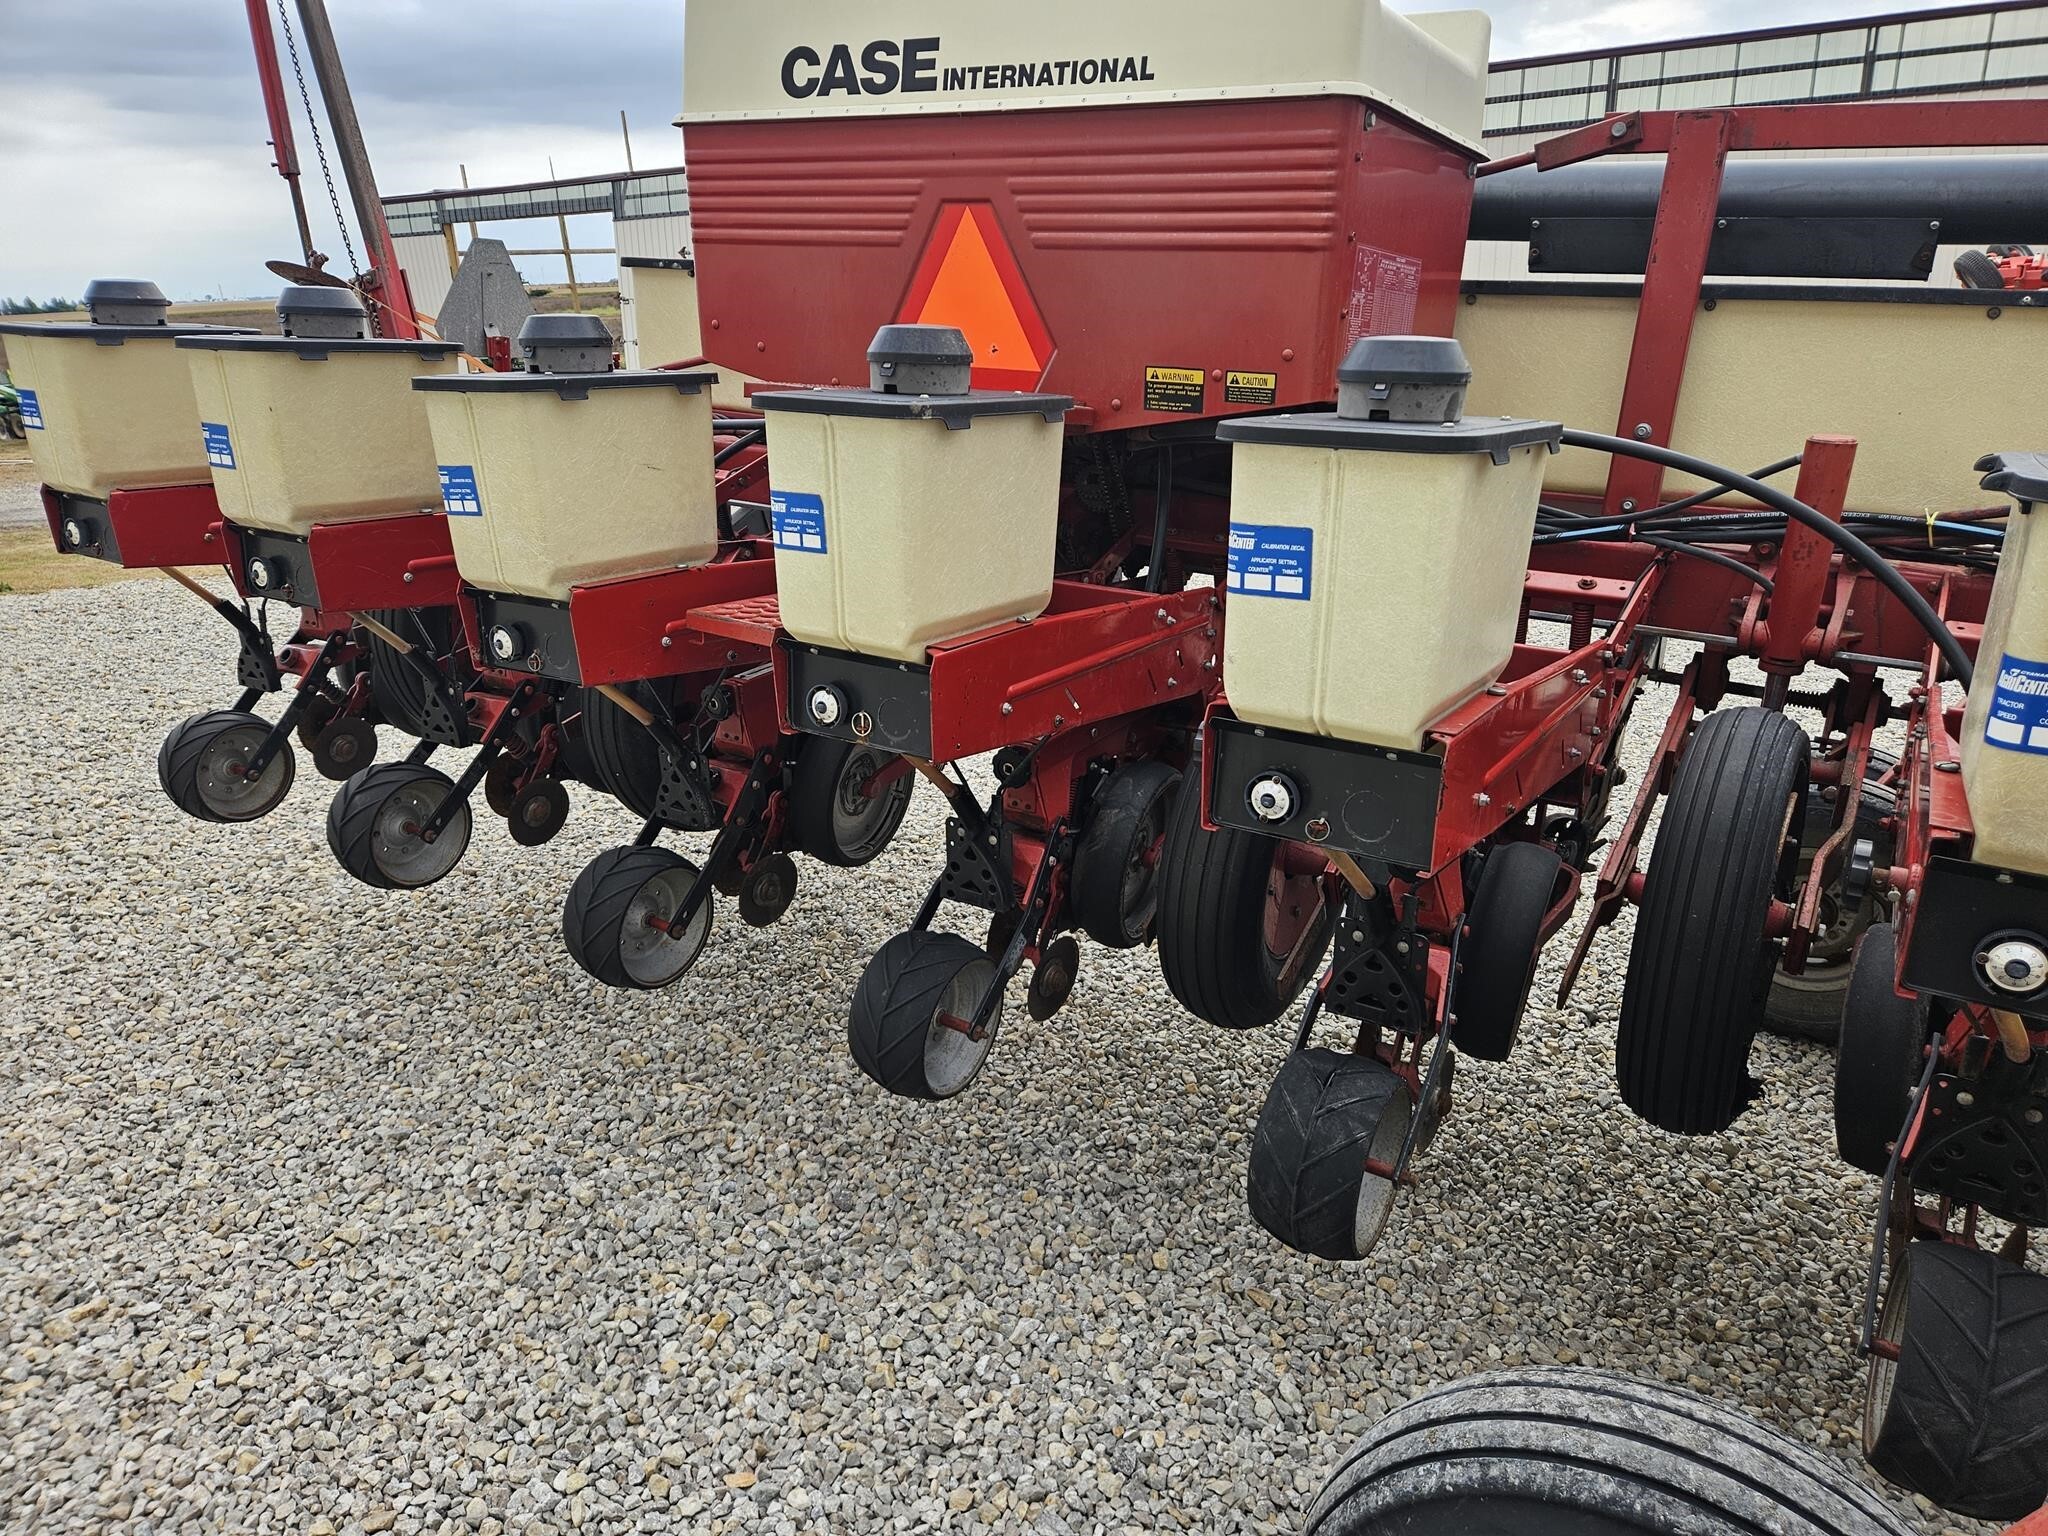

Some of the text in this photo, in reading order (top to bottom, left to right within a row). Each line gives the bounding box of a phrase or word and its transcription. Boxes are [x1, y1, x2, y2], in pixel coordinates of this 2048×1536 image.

[781, 37, 1154, 98] CASE INTERNATIONAL
[1161, 372, 1194, 382] WARNING
[1242, 376, 1268, 386] CAUTION
[1997, 697, 2024, 709] TRACTOR
[1997, 710, 2017, 720] SPEED
